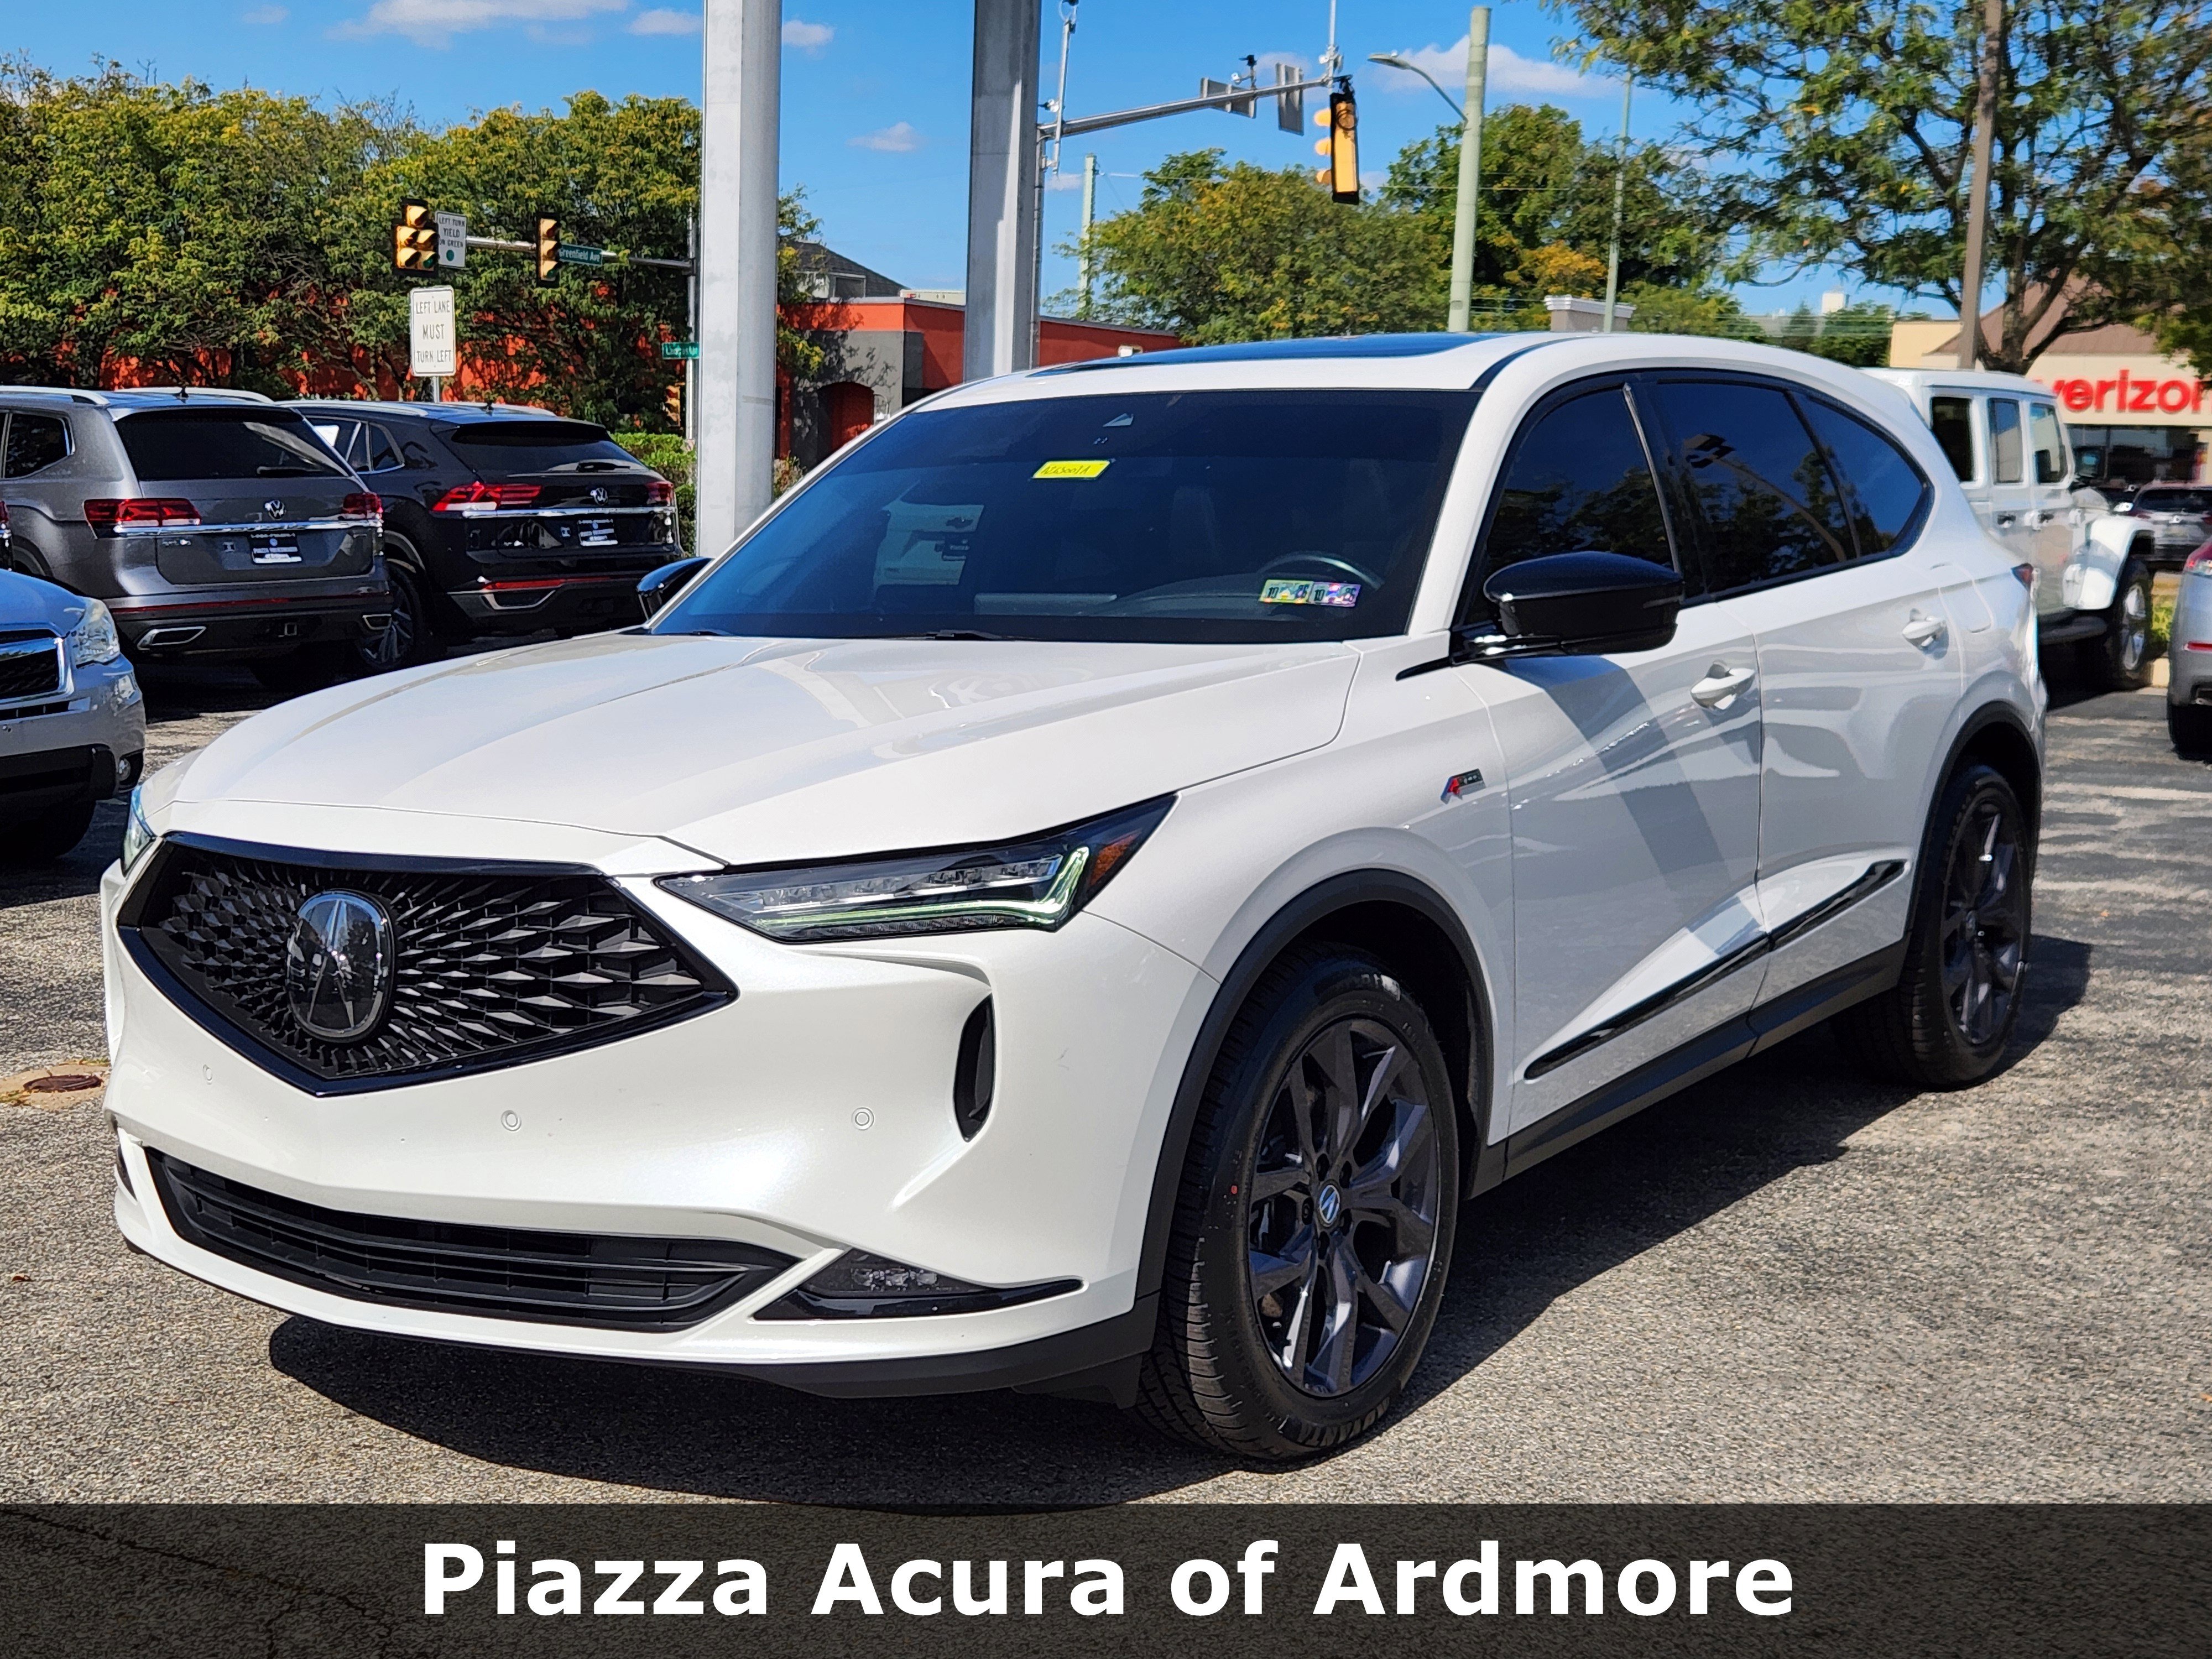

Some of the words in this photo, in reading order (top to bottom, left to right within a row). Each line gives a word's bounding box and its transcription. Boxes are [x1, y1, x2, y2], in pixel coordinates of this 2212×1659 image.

[444, 228, 460, 238] YIELD
[447, 239, 463, 248] GREEN
[589, 251, 600, 262] Ave
[416, 301, 431, 314] LEFT
[434, 300, 450, 314] LANE
[422, 324, 445, 340] MUST
[416, 350, 434, 363] TURN
[437, 349, 452, 363] LEFT
